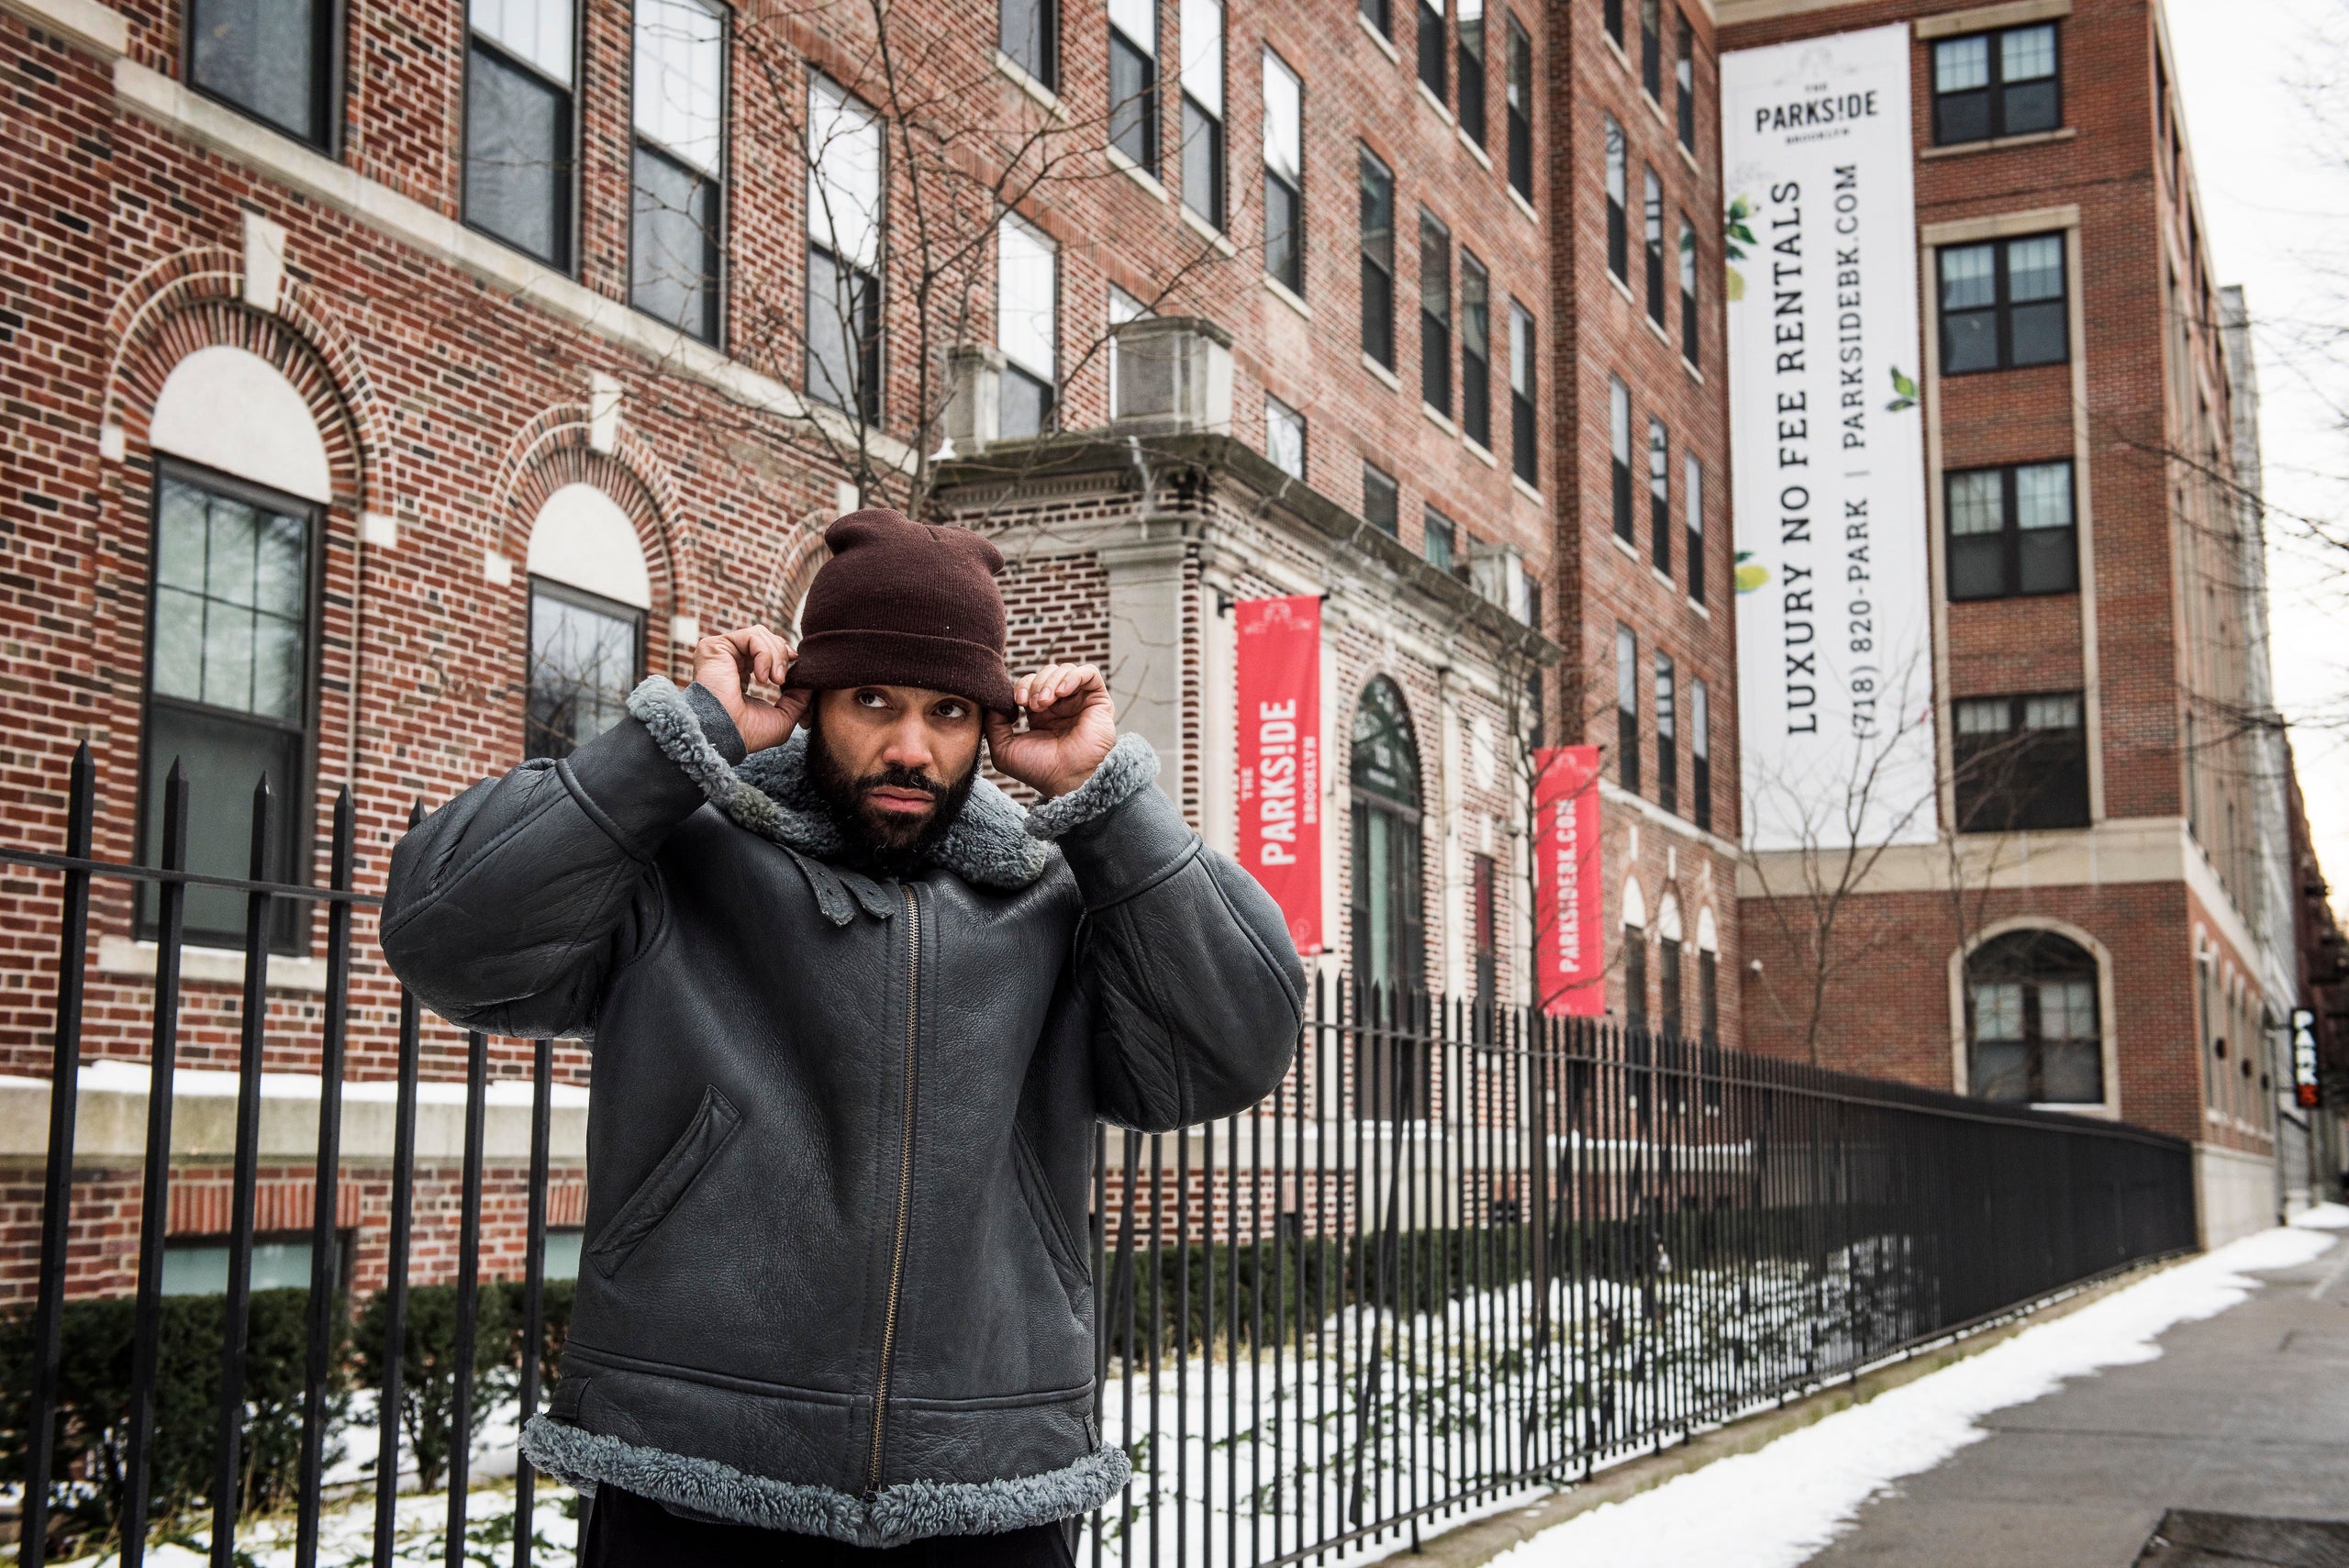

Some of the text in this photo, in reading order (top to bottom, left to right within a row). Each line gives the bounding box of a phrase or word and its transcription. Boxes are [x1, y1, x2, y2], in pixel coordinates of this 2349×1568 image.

[1833, 163, 1866, 450] PARKSIDEBK.COM
[1772, 181, 1818, 737] LUXURY NO FEE RENTALS
[1845, 499, 1873, 654] 820-PARK
[1849, 666, 1882, 740] (718)
[1242, 768, 1253, 800] THE
[1304, 737, 1317, 824] BROOKLYN
